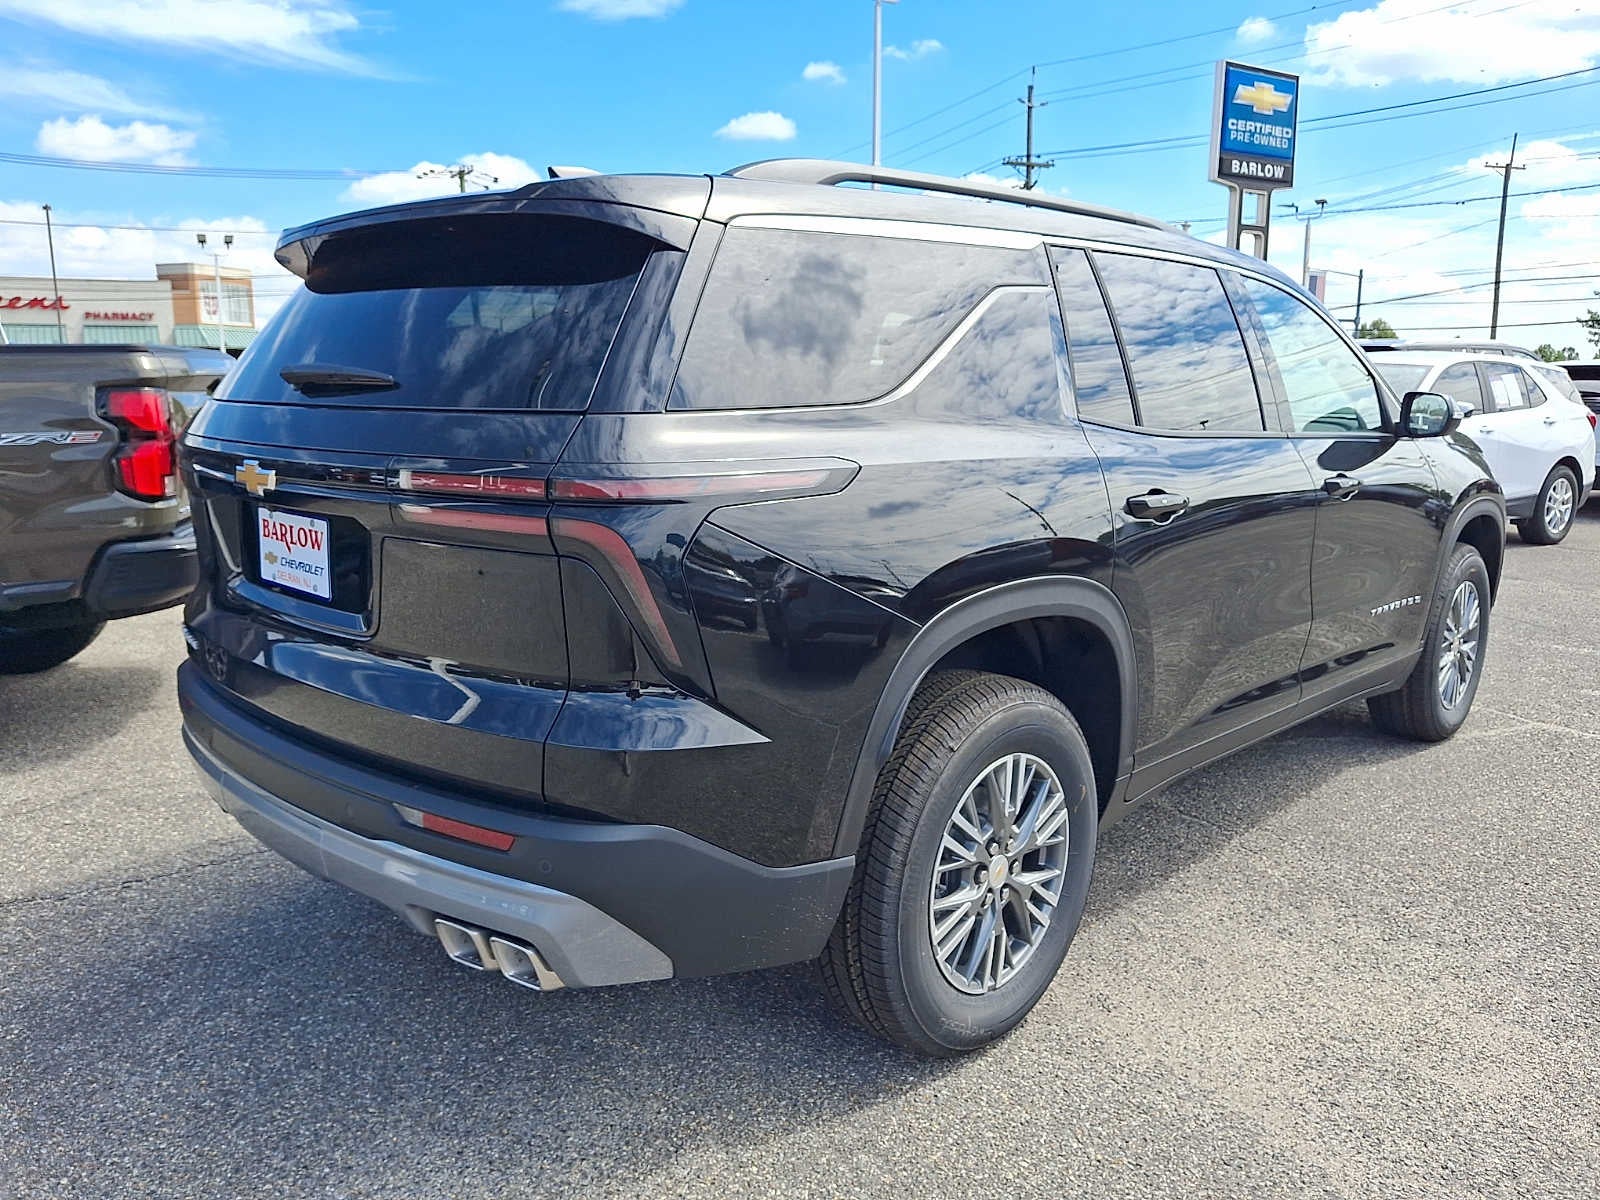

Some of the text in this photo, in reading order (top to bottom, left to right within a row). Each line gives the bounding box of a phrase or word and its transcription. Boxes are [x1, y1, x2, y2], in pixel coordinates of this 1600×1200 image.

[1228, 119, 1291, 138] CERTIFIED
[1230, 130, 1289, 149] PRE-OWNED
[1231, 160, 1284, 178] BARLOW
[0, 296, 70, 310] ens
[84, 311, 154, 321] PHARMACY
[262, 518, 323, 553] BARLOW
[280, 556, 324, 577] CHEVROLET
